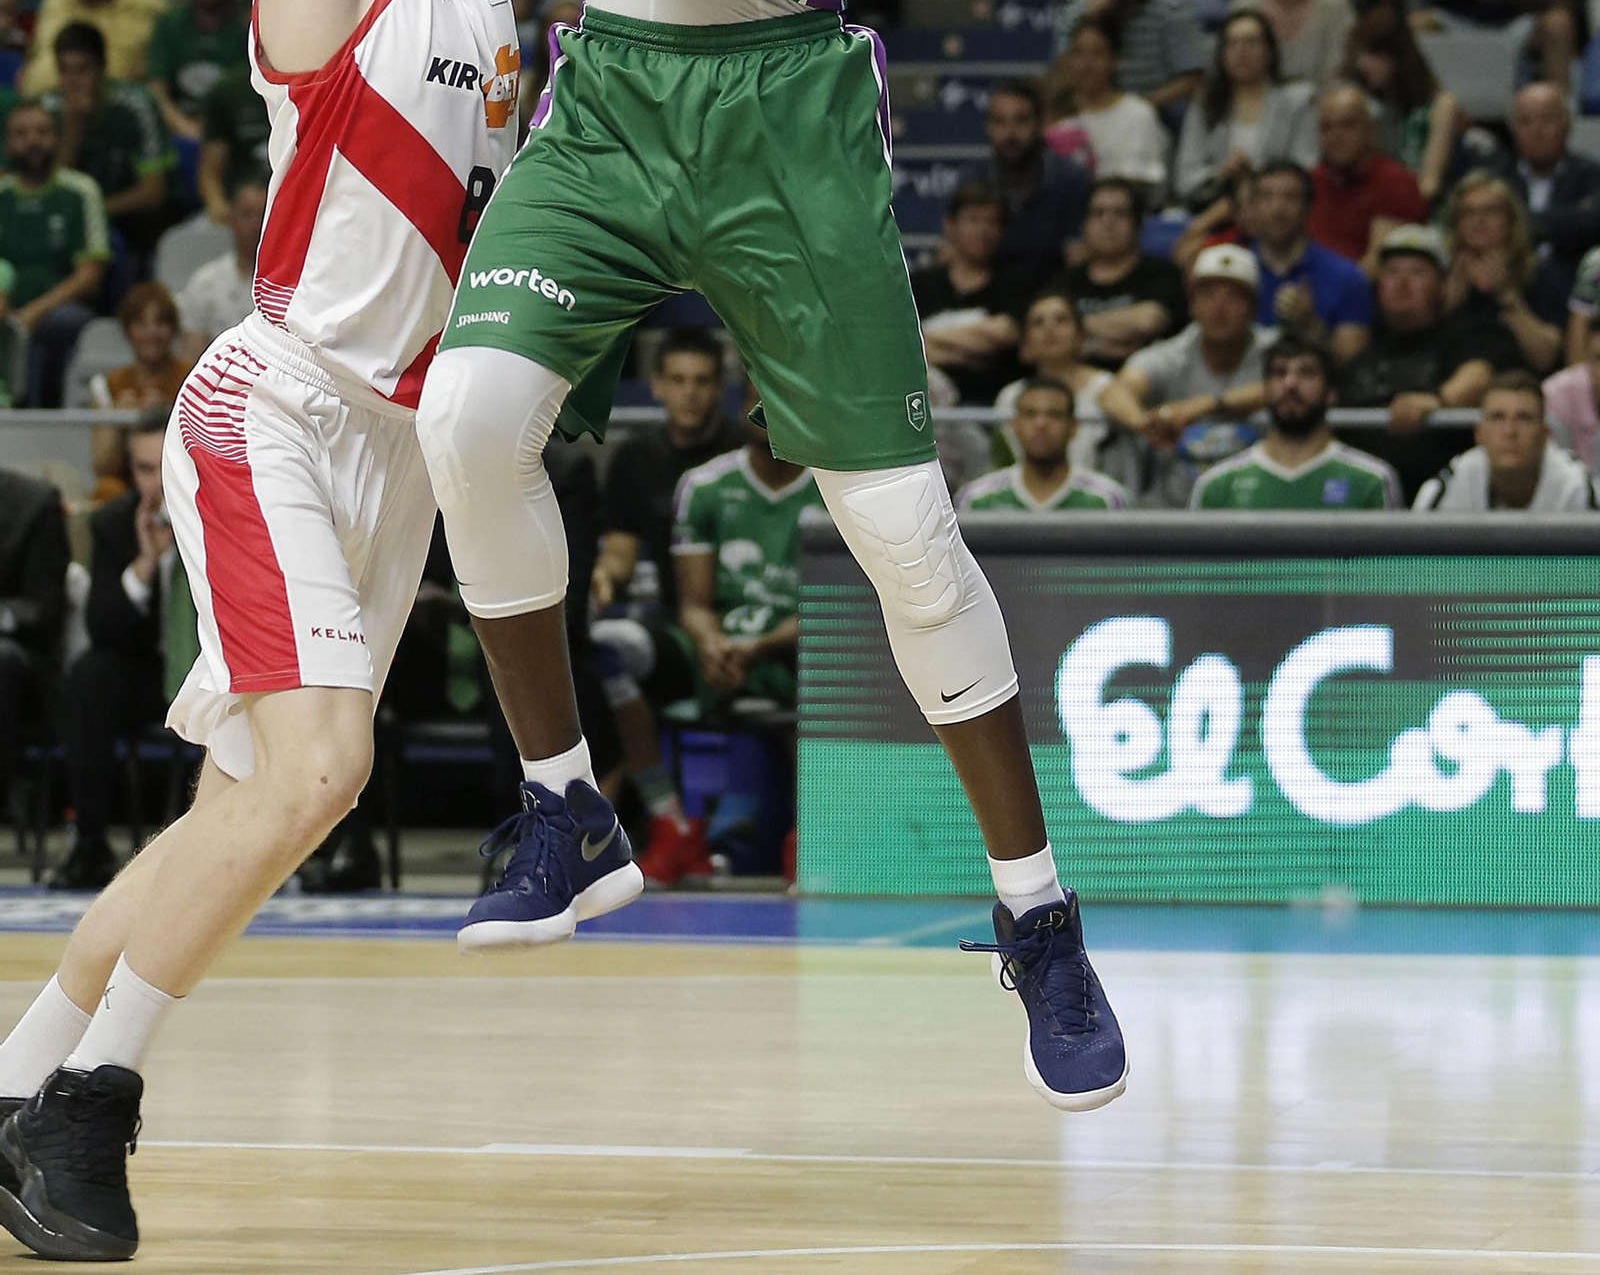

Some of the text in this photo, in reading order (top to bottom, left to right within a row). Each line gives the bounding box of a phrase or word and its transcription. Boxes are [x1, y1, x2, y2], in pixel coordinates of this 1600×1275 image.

[457, 165, 497, 245] 8
[469, 267, 577, 312] worten
[455, 311, 511, 329] SPALDING
